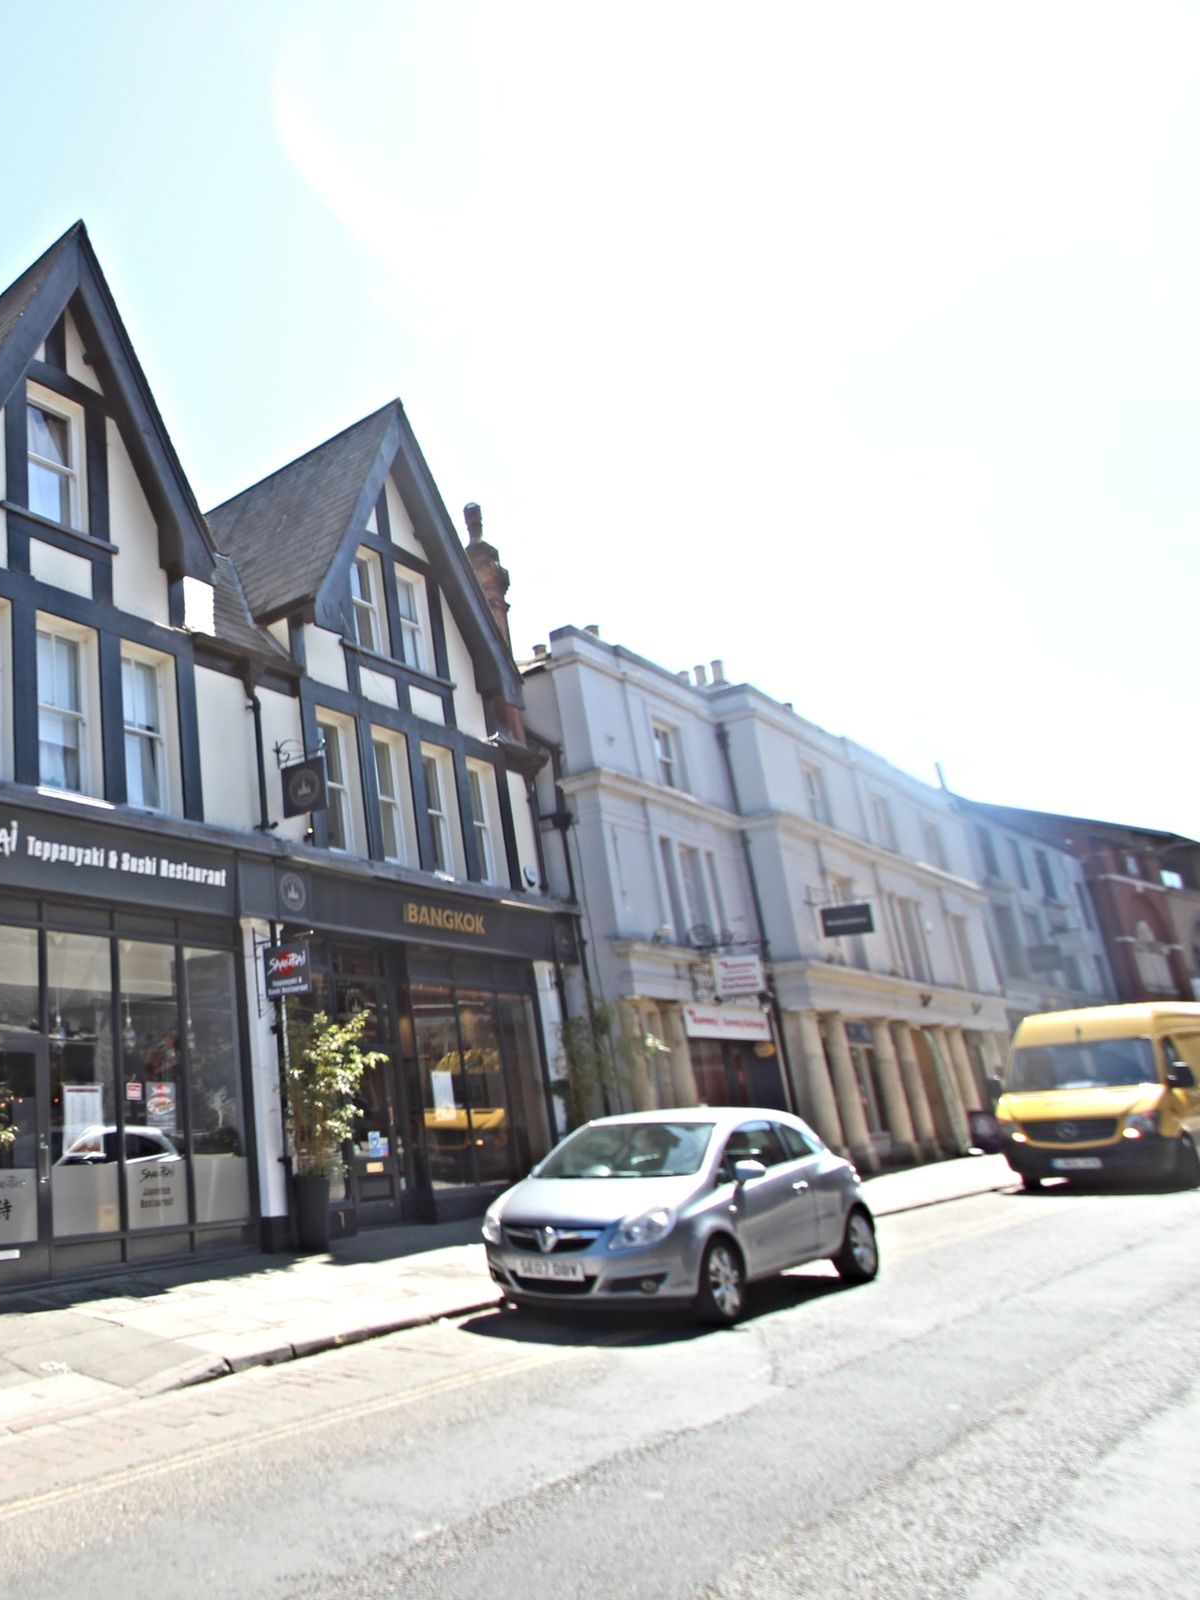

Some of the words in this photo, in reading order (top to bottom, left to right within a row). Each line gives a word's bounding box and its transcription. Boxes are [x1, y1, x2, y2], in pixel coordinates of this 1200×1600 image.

[26, 835, 104, 867] Teppanyaki
[108, 850, 119, 870] &
[120, 852, 157, 876] Sushi
[160, 858, 227, 887] Restaurant
[404, 902, 486, 934] BANGKOK
